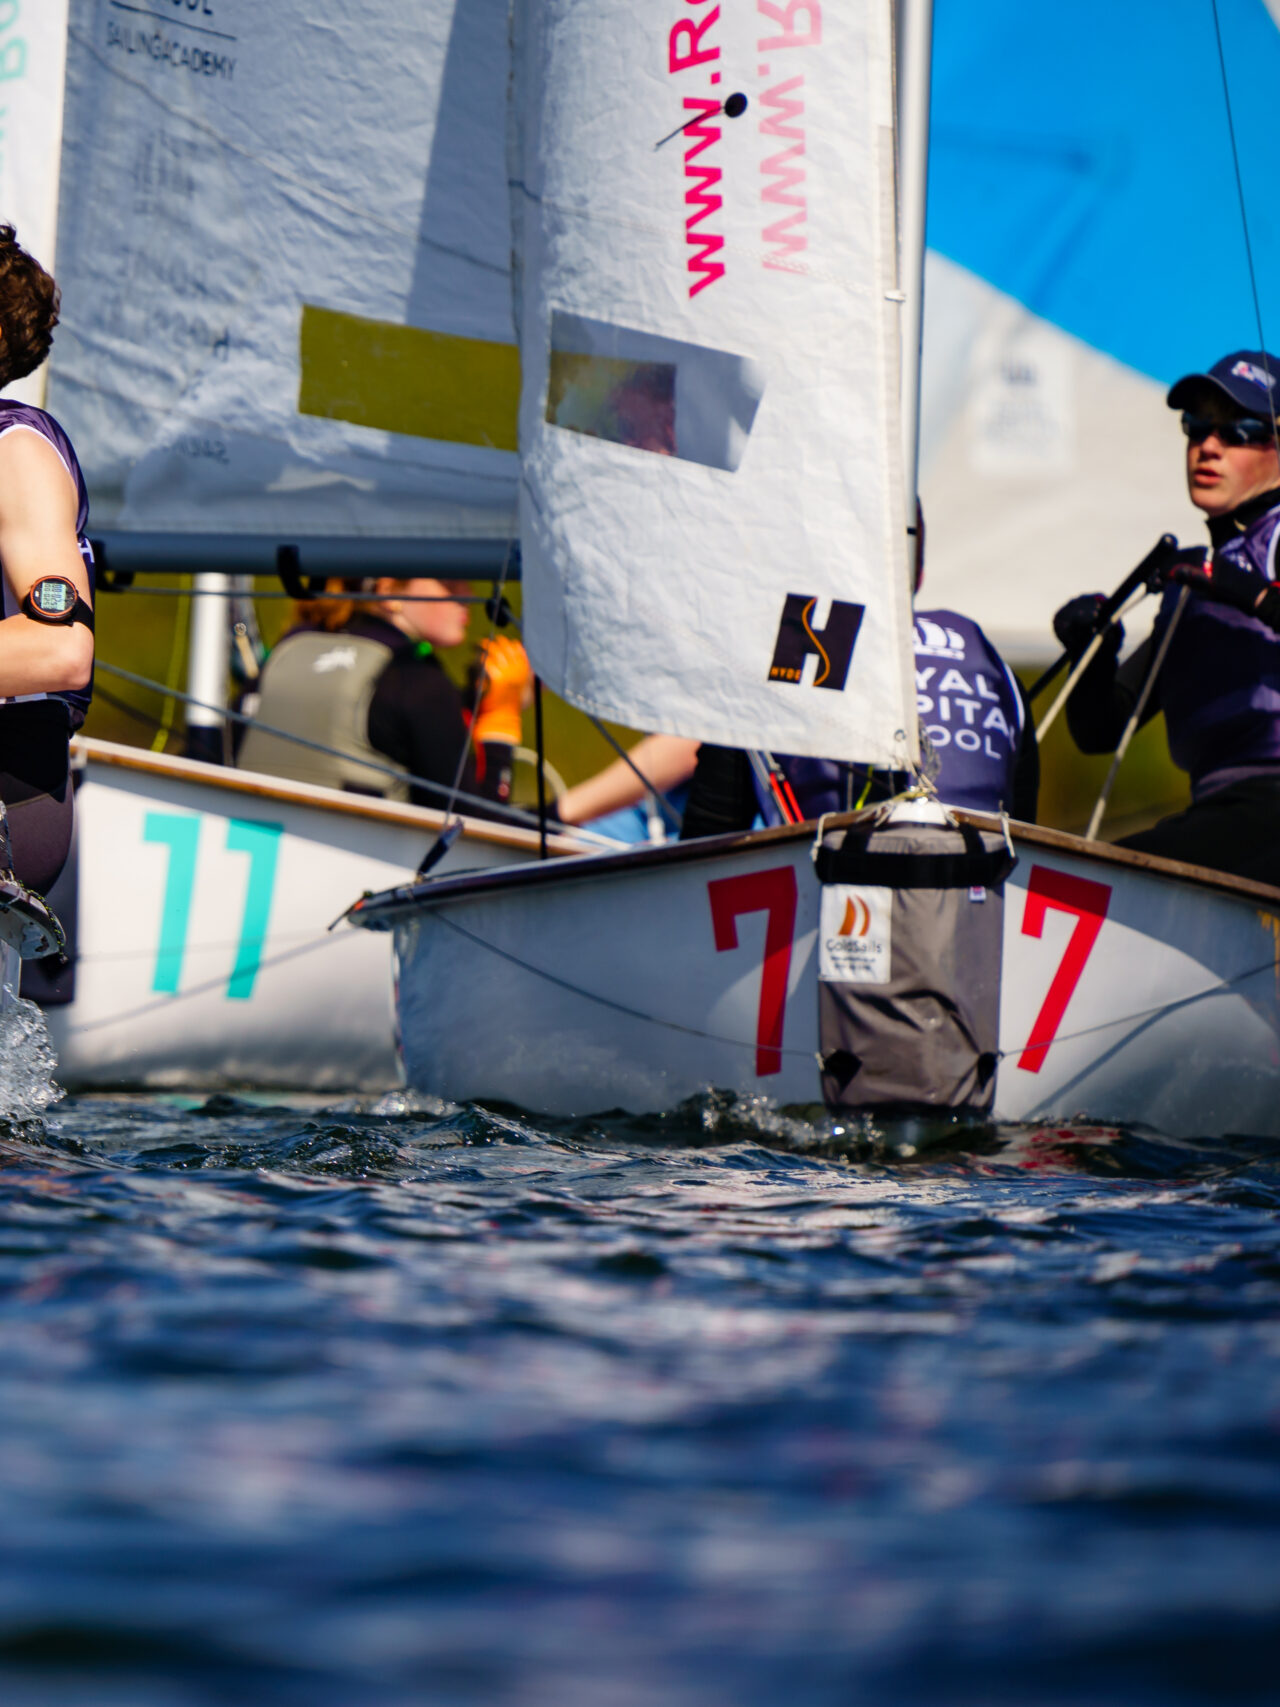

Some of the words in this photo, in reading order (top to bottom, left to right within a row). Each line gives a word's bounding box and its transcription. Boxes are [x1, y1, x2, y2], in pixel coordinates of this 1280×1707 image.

[668, 0, 726, 300] www.R
[769, 666, 802, 682] HYDE
[915, 666, 1000, 701] YAL
[925, 724, 1002, 760] OOL
[142, 810, 286, 1002] 11
[707, 864, 799, 1078] 7
[1016, 864, 1113, 1075] 7
